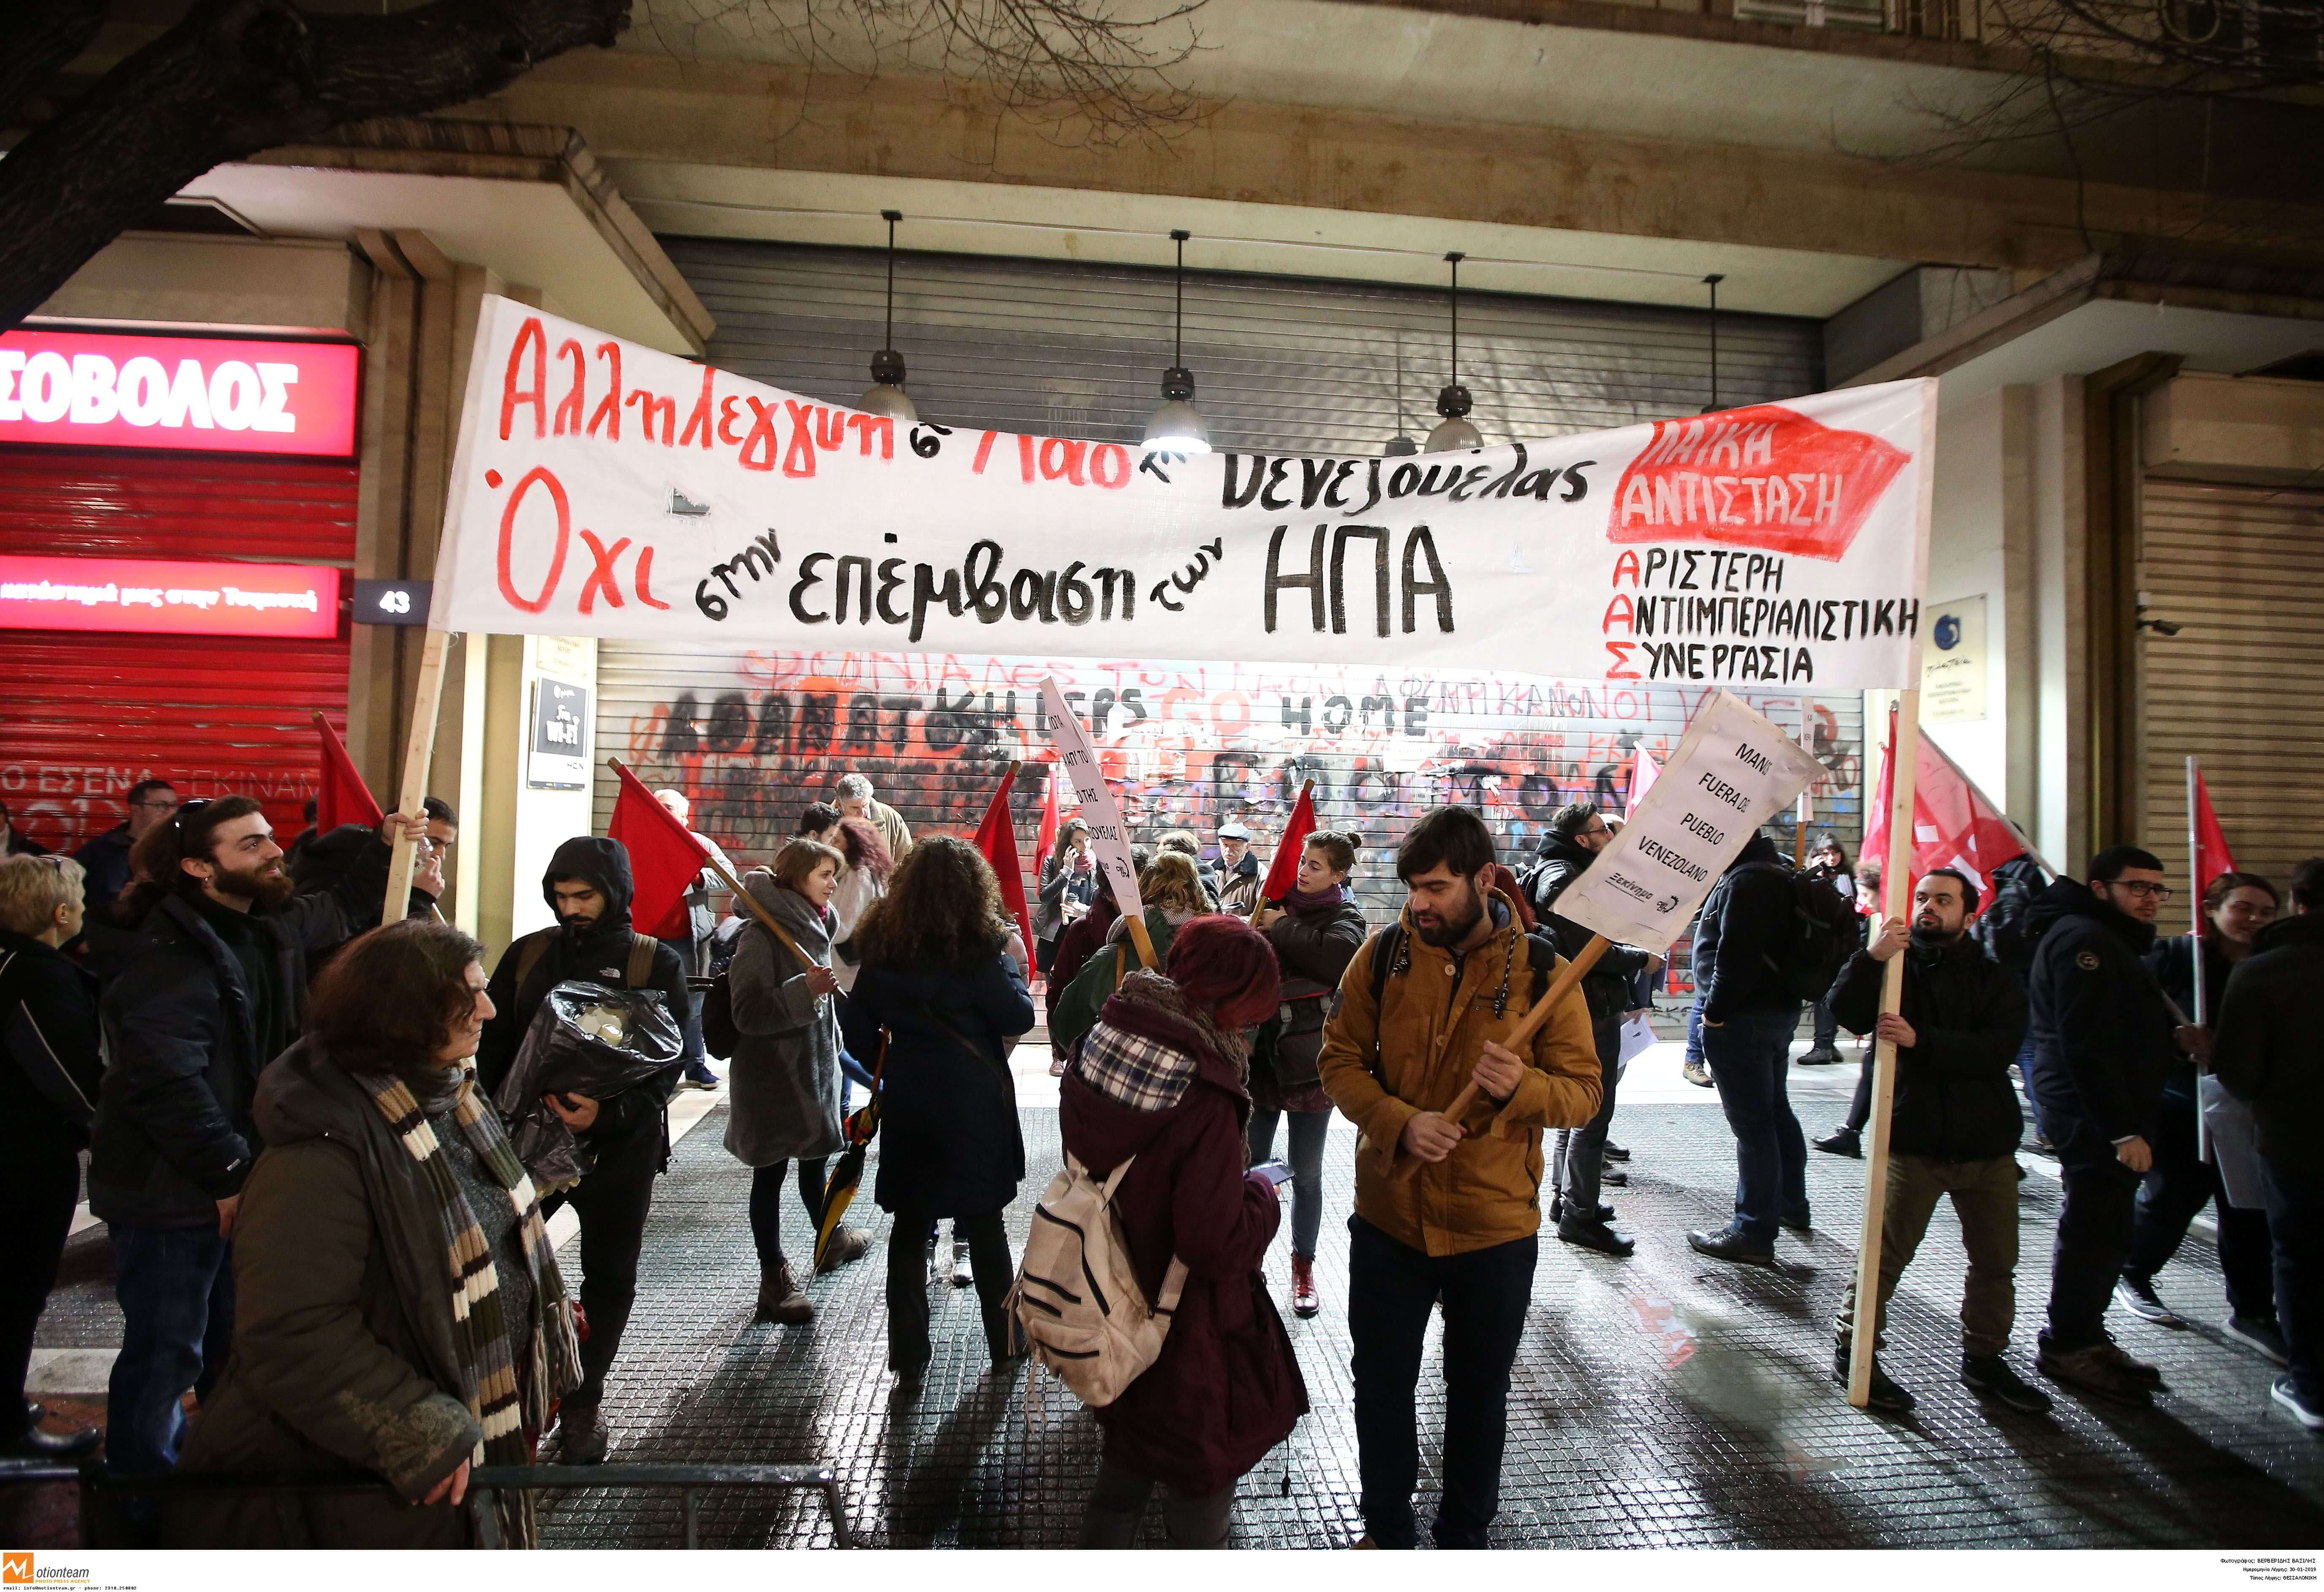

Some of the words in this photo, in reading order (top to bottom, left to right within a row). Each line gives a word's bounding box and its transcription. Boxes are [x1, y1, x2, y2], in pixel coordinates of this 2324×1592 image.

[1622, 472, 1843, 527] ΑΝΤΙΣΤΑΣΗ
[1265, 521, 1455, 638] ΗΠΑ
[1612, 548, 1784, 593] ΑΡΙΣΤΕΡΗ
[379, 590, 411, 614] 43
[1603, 593, 1920, 641] ΑΝΤΙΙΜΠΕΡΙΑΛΙΣΤΙΚΗ
[1606, 641, 1814, 682] ΣΥΝΕΡΓΑΣΙΑ
[1281, 695, 1430, 737] HOME
[1081, 788, 1098, 803] ΤΗΣ
[1698, 772, 1740, 807] FUERA
[1680, 813, 1724, 845] PUEBLO
[1639, 835, 1708, 882] VENEZOLANO
[1609, 872, 1654, 900] Ξεκίνημα
